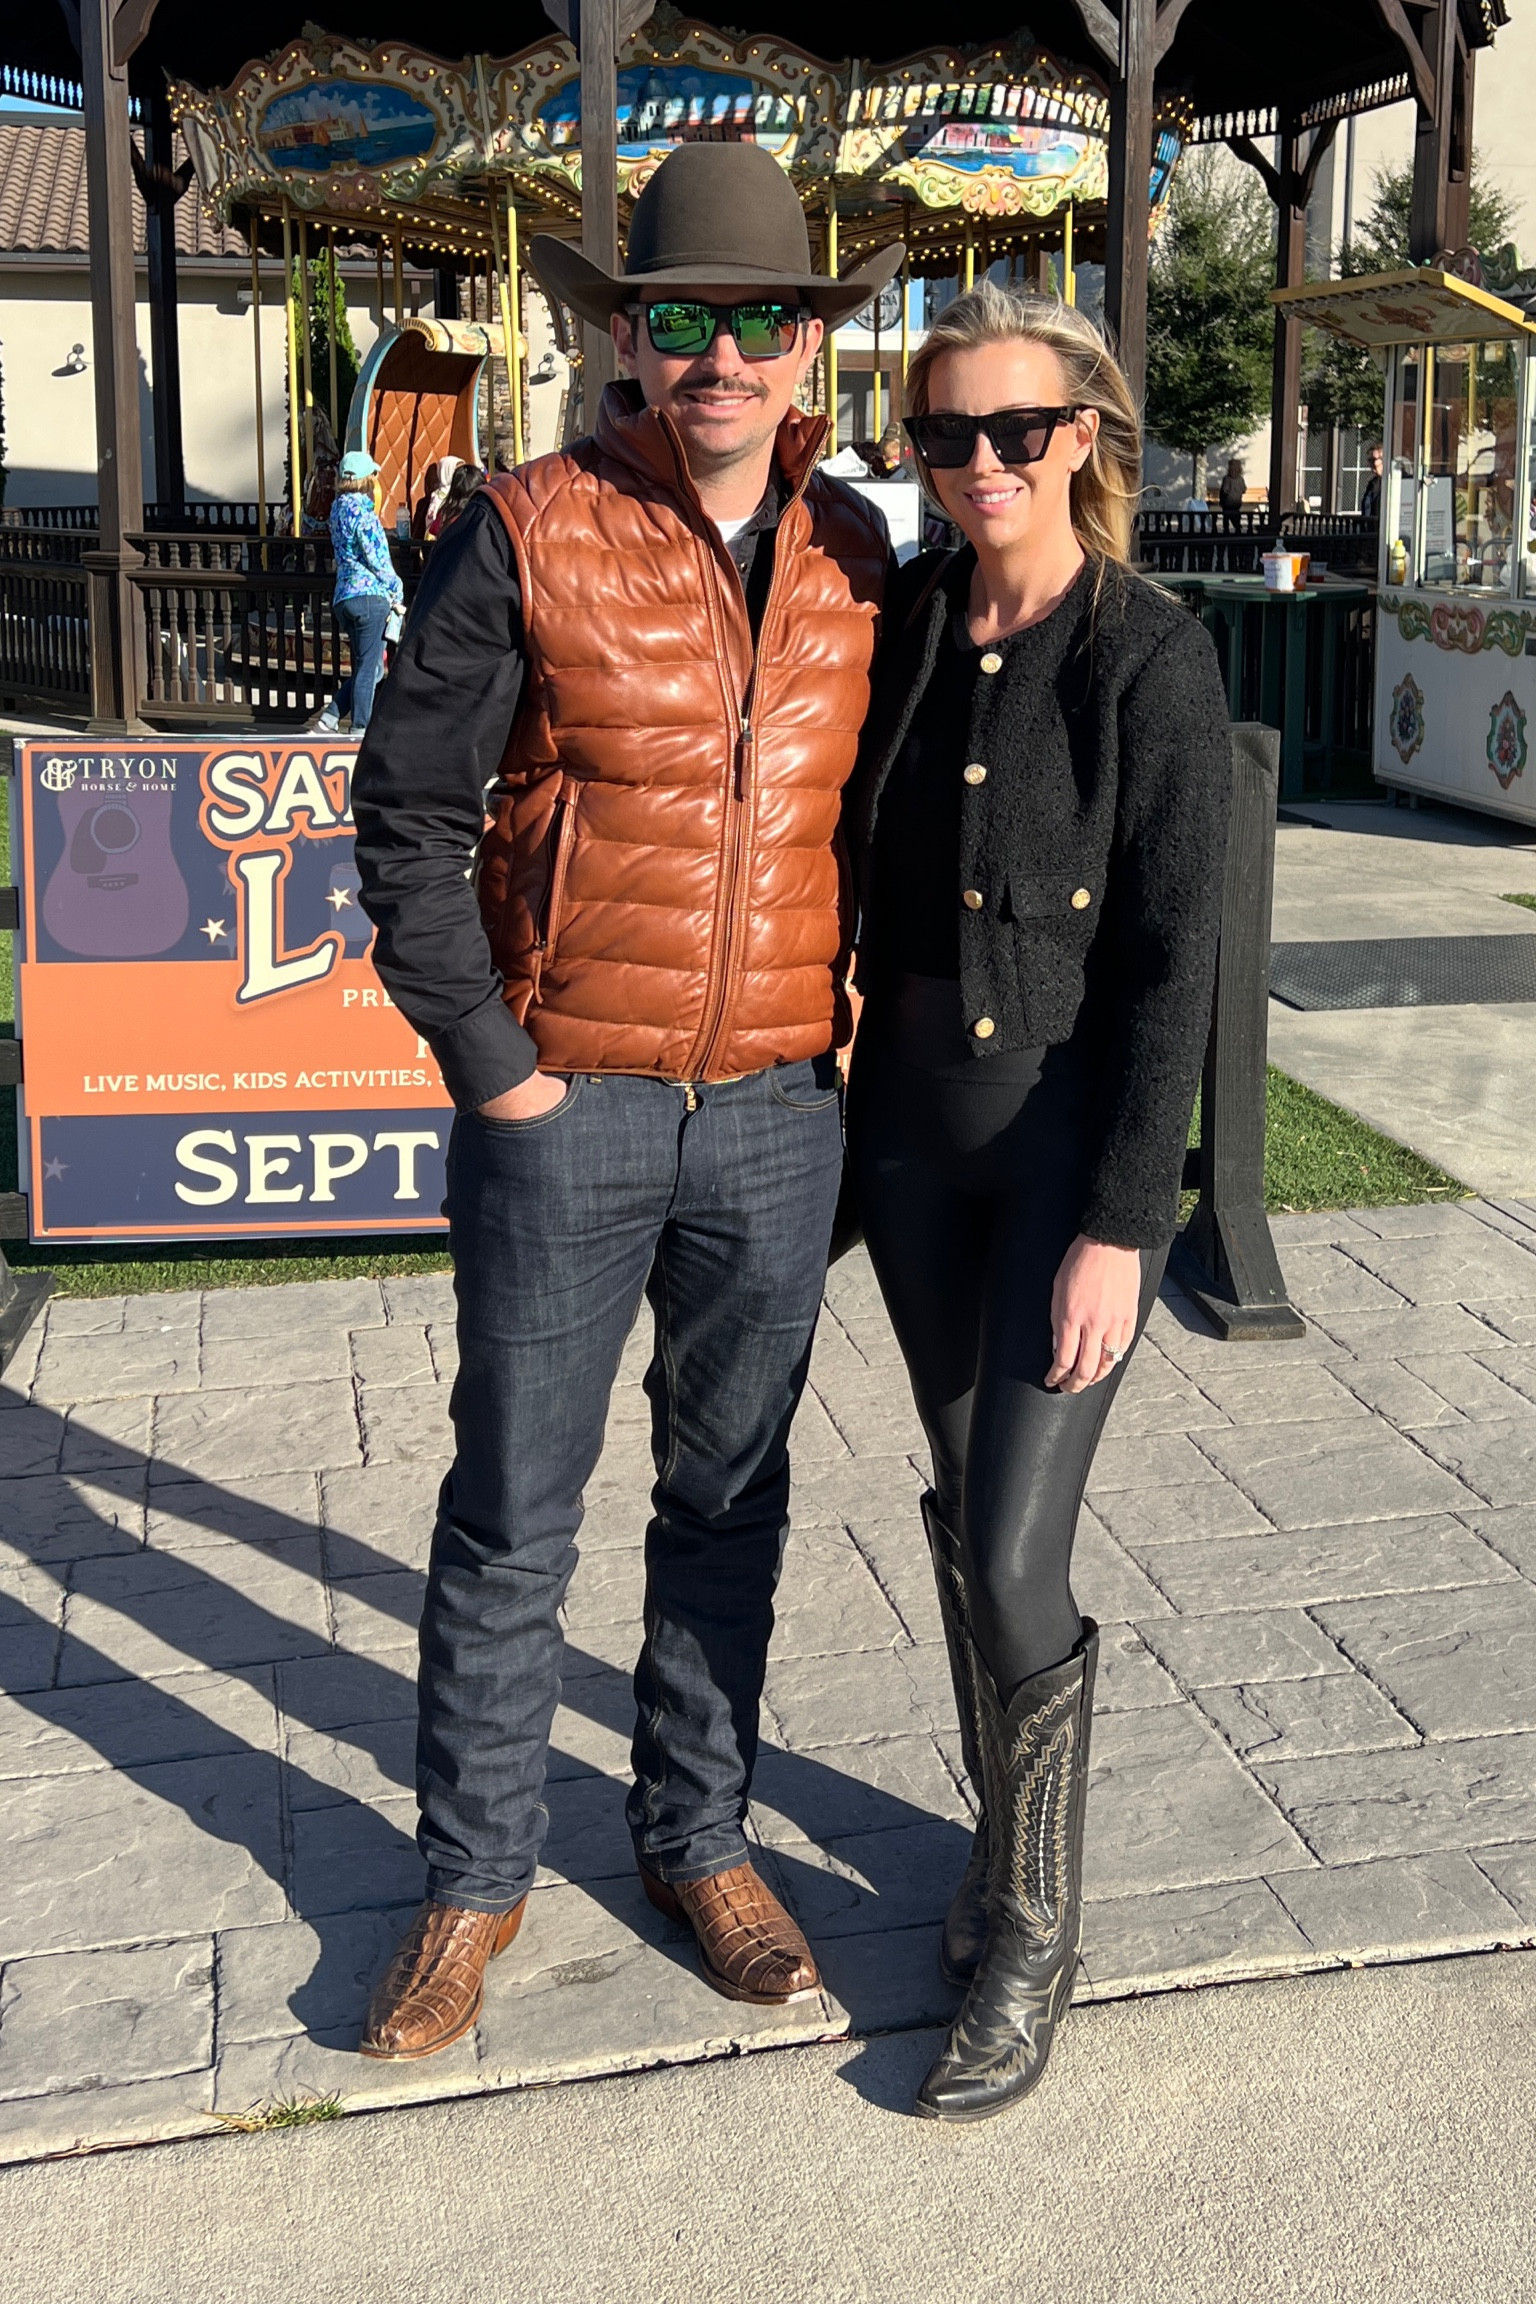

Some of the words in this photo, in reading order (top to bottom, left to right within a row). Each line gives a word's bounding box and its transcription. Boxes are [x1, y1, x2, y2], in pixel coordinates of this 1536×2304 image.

[78, 758, 177, 779] TRYON
[81, 783, 121, 791] HORSE
[126, 782, 137, 792] &
[142, 783, 176, 791] HOME
[83, 1075, 139, 1093] LIVE
[146, 1072, 226, 1092] MUSIC,
[233, 1071, 287, 1090] KIDS
[295, 1069, 432, 1088] ACTIVITIES,
[174, 1129, 439, 1206] SEPT
